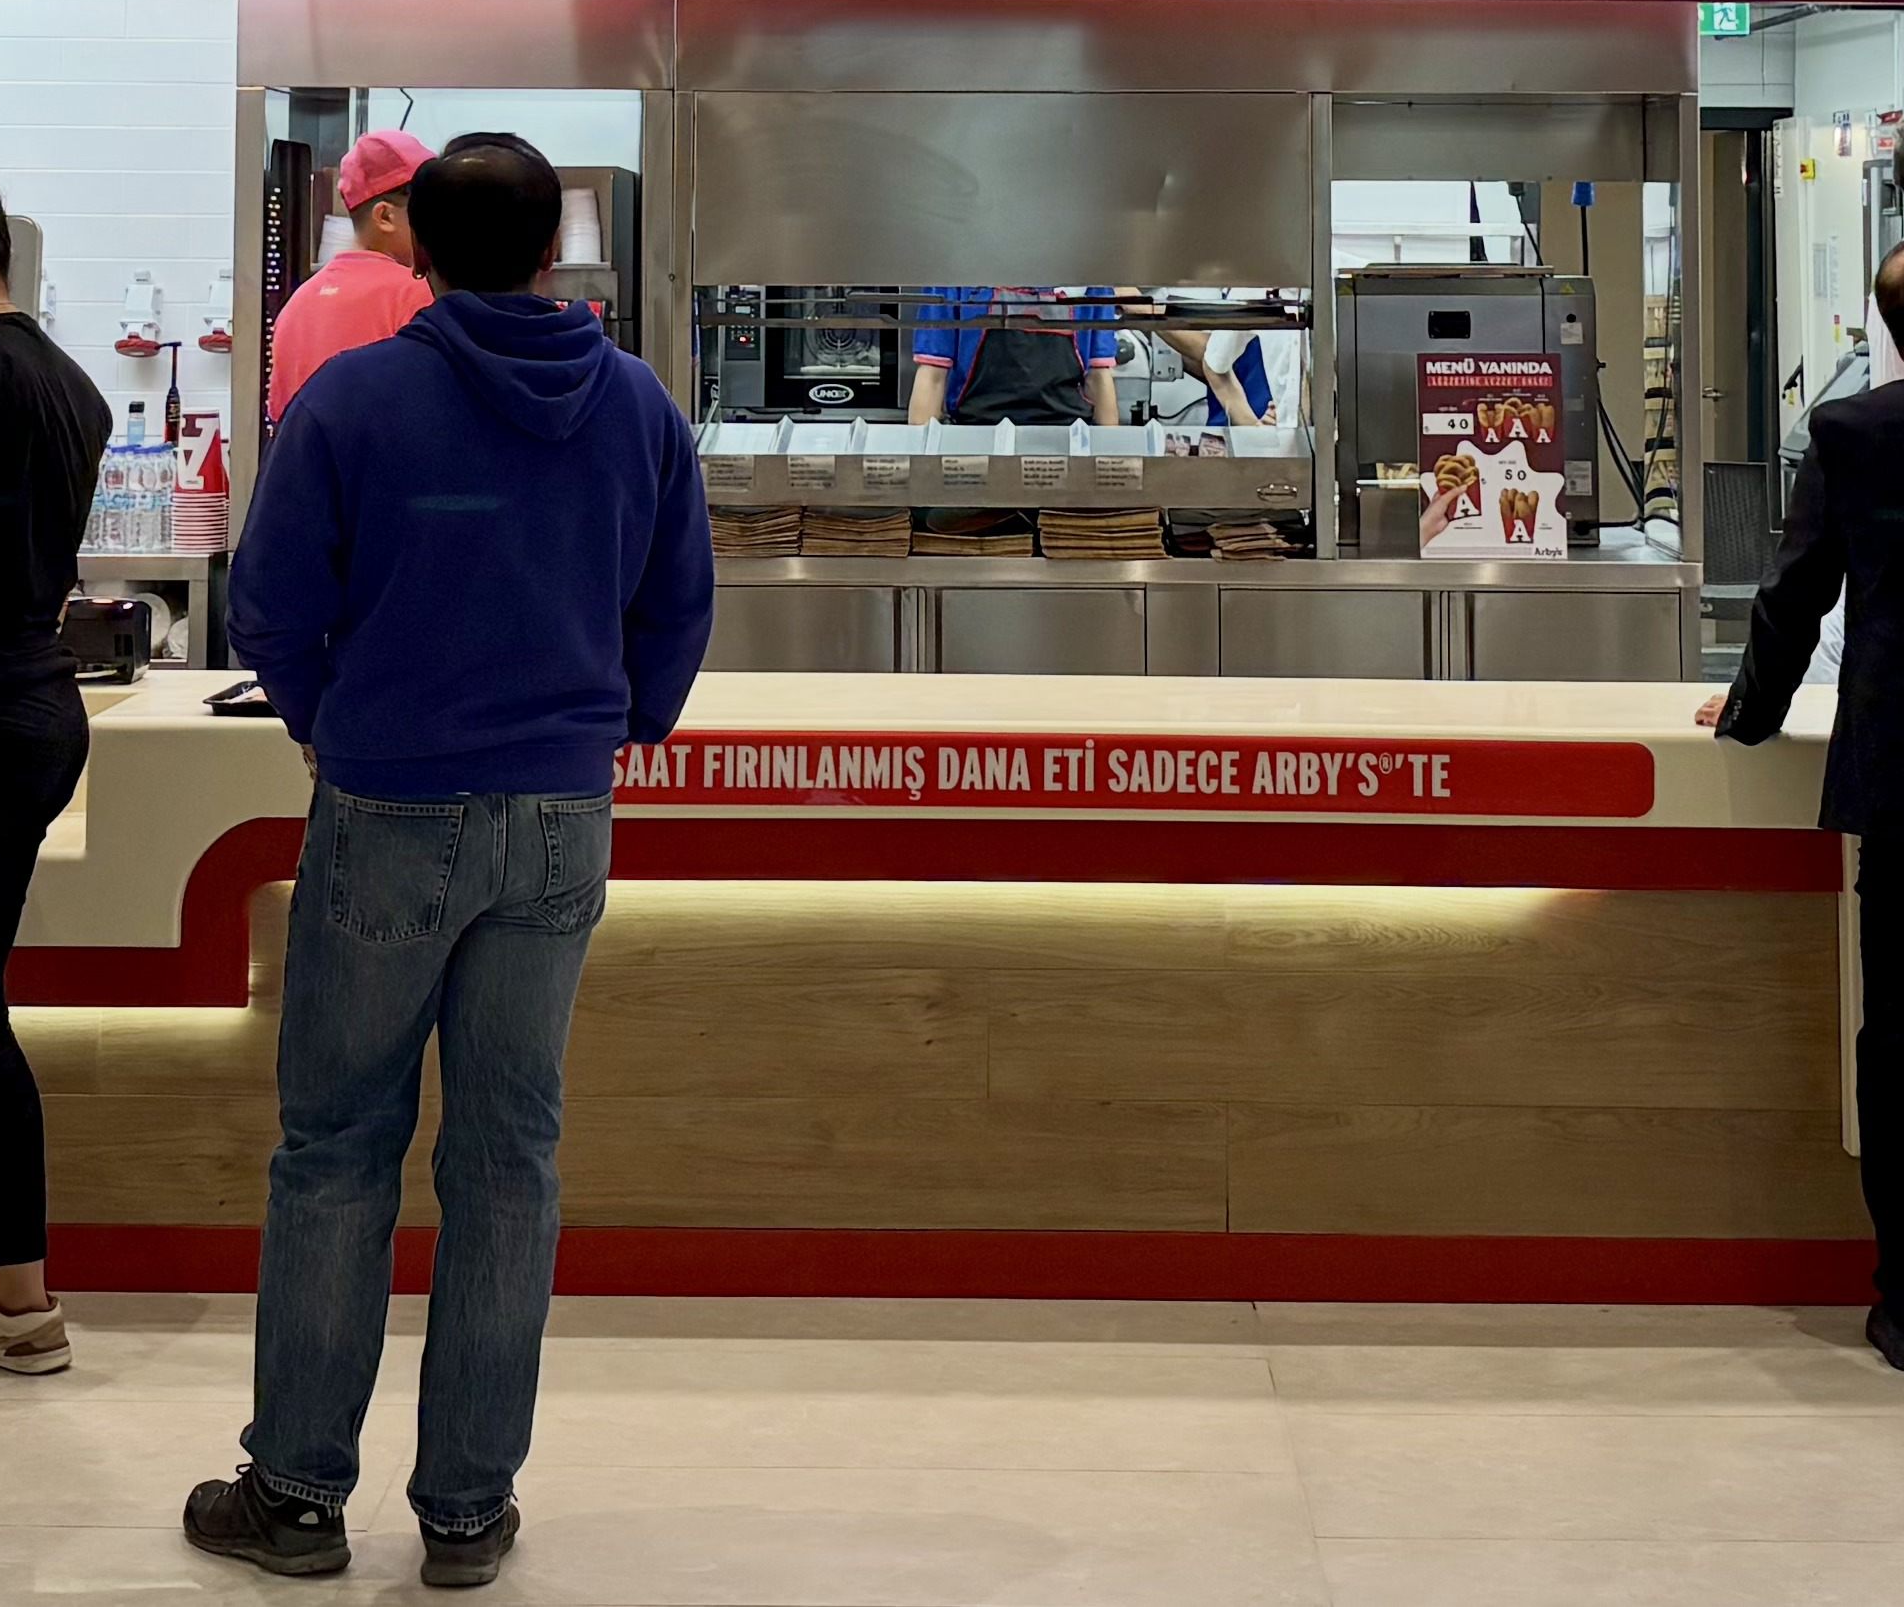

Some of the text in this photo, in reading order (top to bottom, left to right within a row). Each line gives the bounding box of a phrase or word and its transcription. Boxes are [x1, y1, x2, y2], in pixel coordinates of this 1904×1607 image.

[1426, 358, 1552, 374] MENÜ YANINDA
[612, 744, 691, 788] SAAT
[703, 745, 925, 799] FIRINLANMIŞ
[939, 747, 1030, 790] DANA
[1043, 739, 1094, 792] ETİ
[1108, 748, 1239, 794] SADECE
